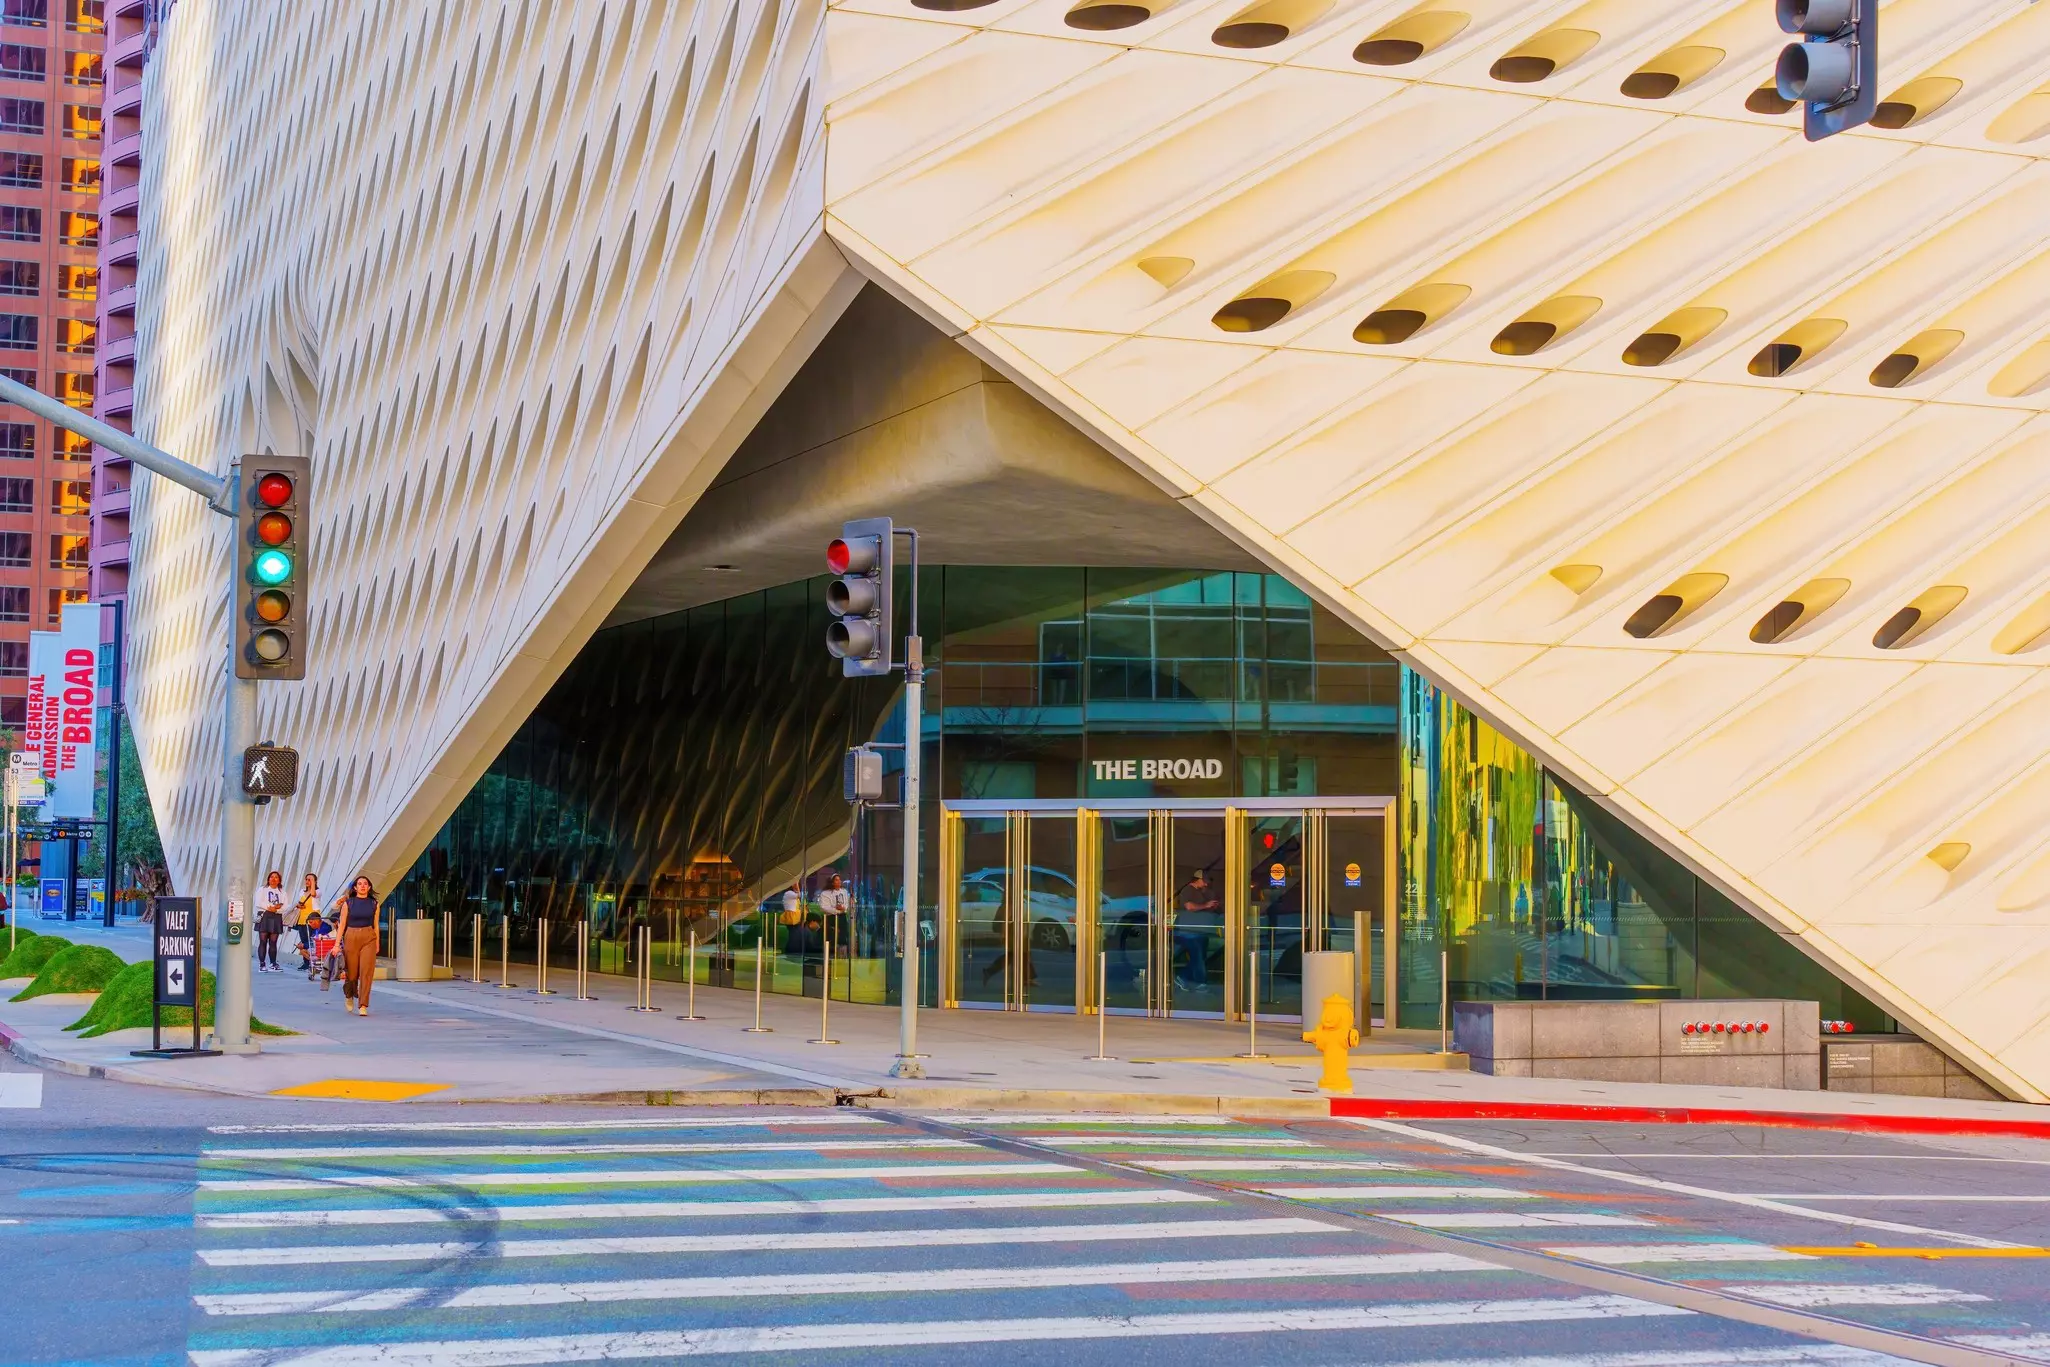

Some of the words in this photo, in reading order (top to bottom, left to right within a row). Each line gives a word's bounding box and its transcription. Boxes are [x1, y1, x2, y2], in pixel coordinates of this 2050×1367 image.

[27, 674, 45, 741] GENERAL
[62, 648, 95, 744] BROAD
[43, 696, 60, 779] ADMISSION
[61, 745, 76, 771] THE
[1092, 760, 1137, 780] THE
[1142, 758, 1223, 779] BROAD
[165, 910, 189, 930] VALET
[159, 936, 194, 956] PARKING
